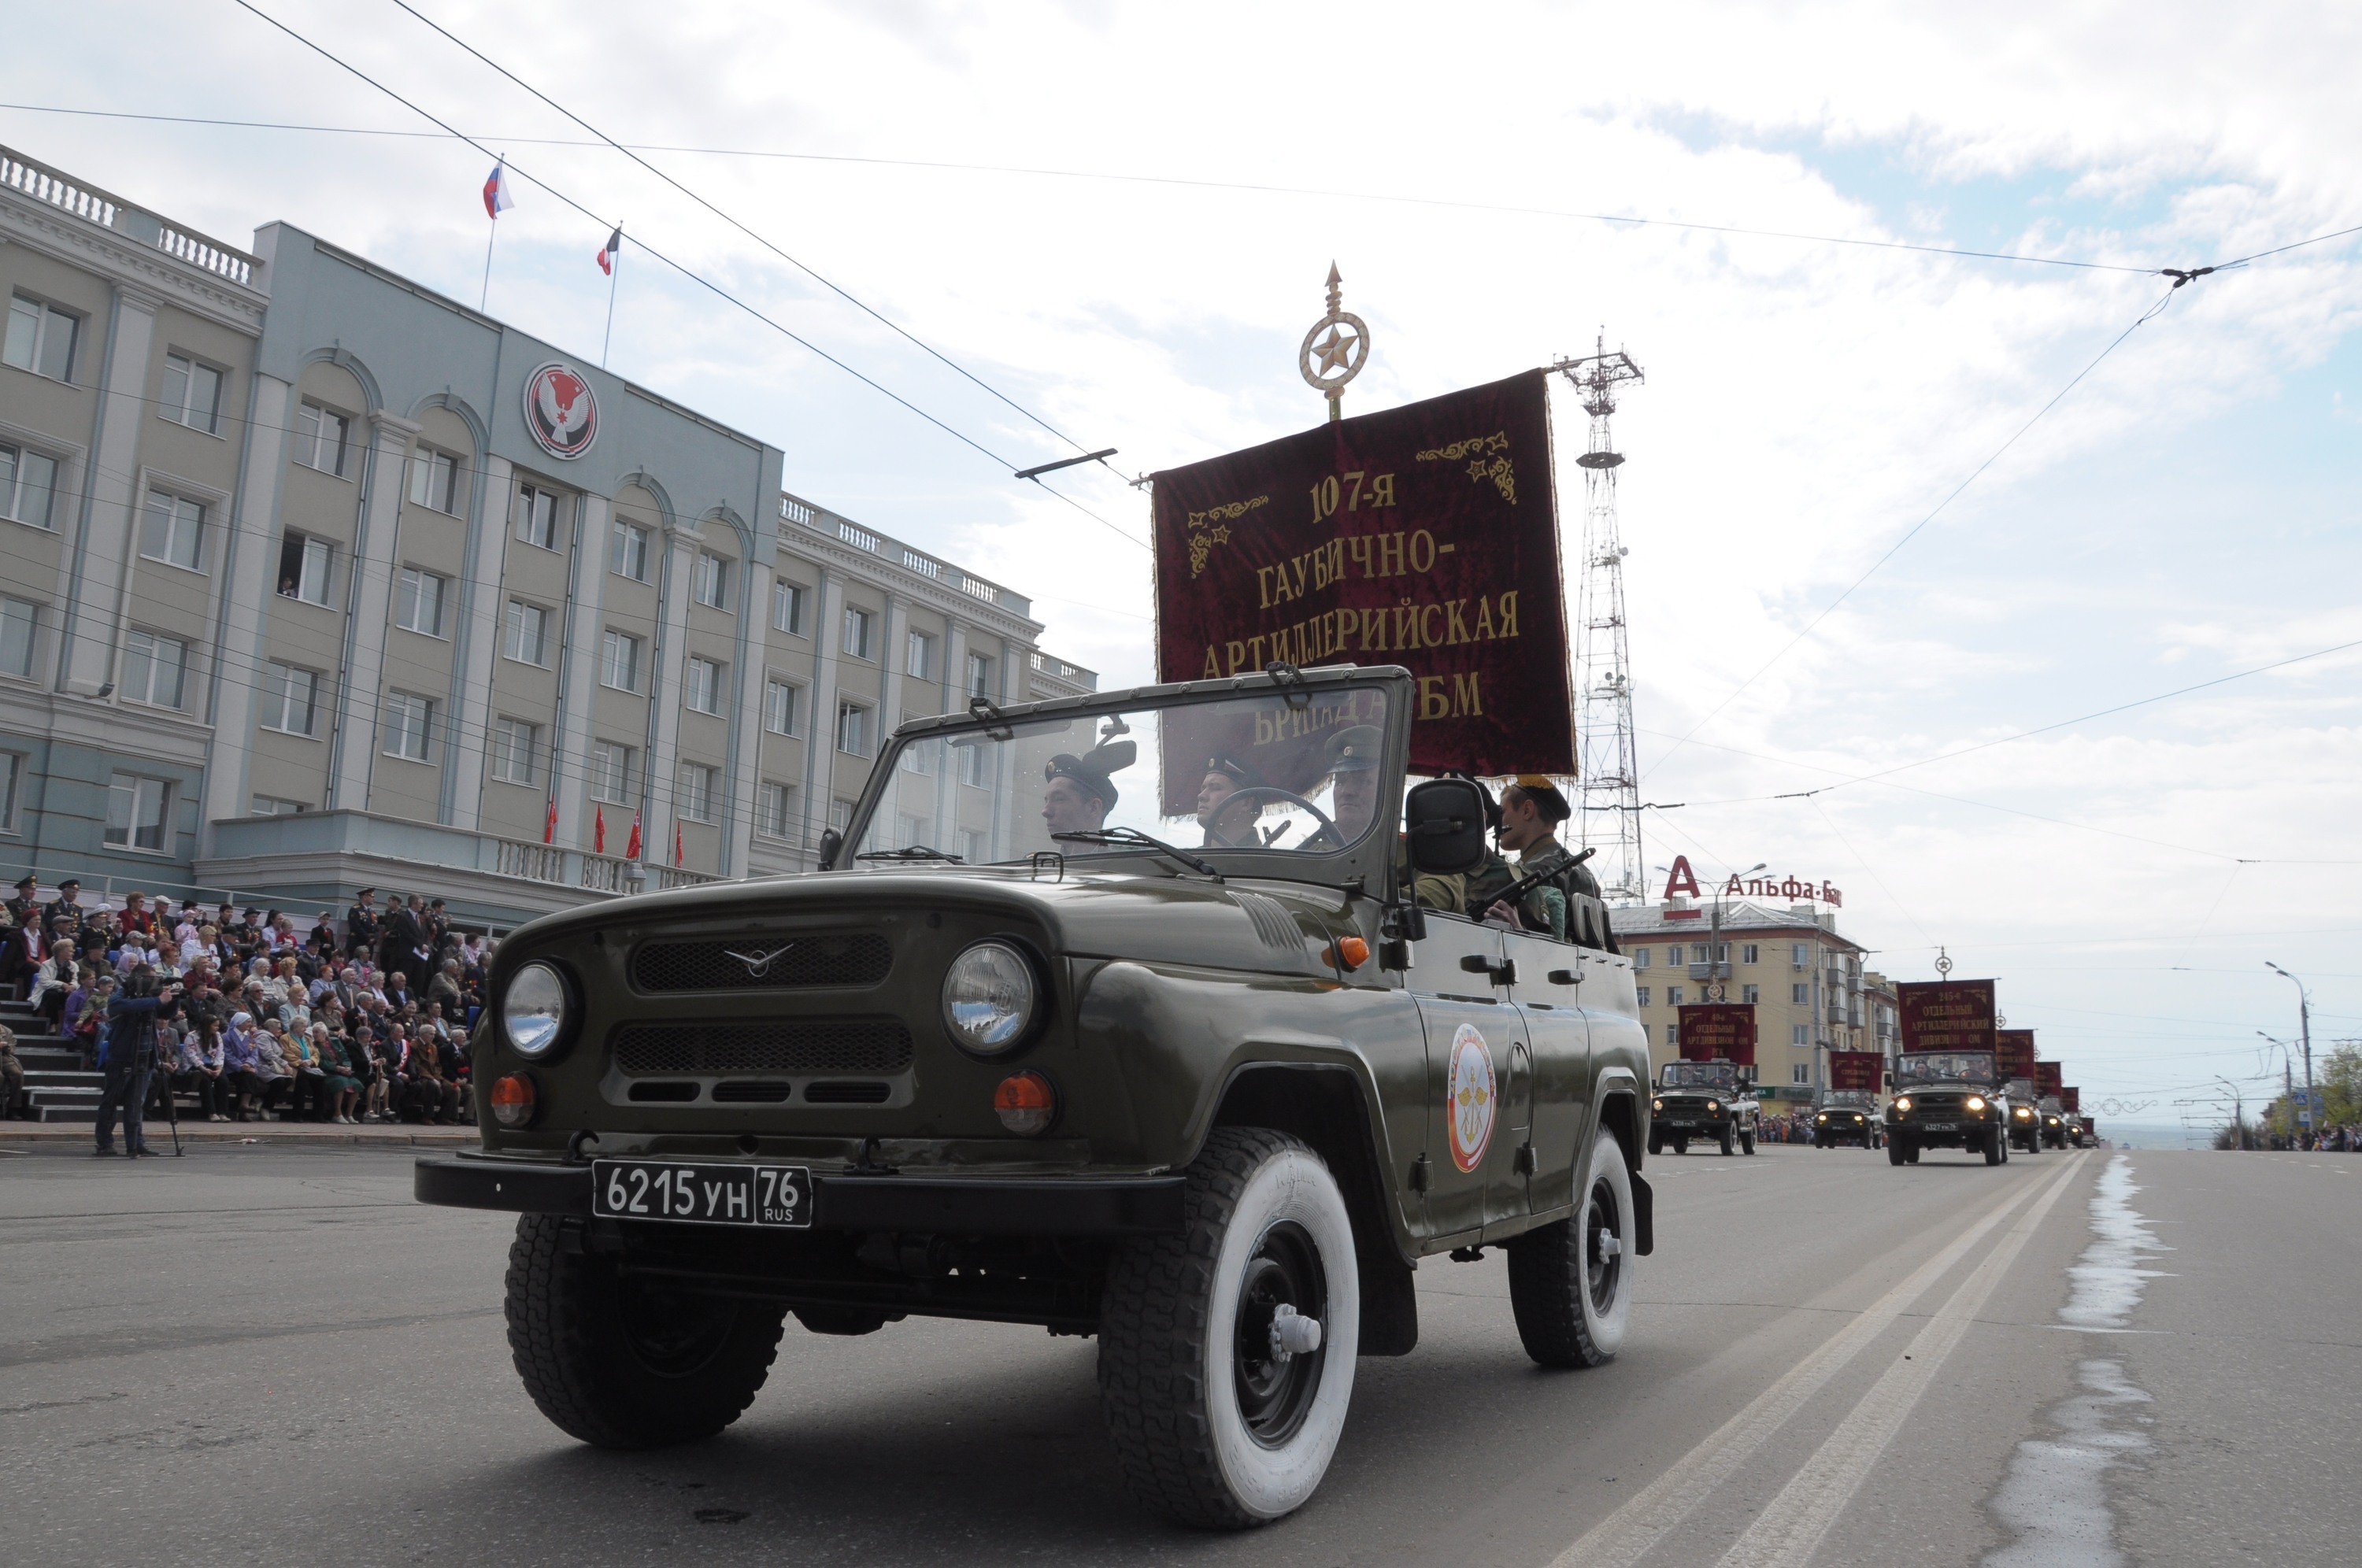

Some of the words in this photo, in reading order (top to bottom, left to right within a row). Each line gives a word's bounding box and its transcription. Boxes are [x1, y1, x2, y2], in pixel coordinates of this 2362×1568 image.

[1257, 529, 1455, 610] ГАУБИЧНО-
[1203, 590, 1520, 680] АРТИЛЛЕРИЙСКАЯ
[1417, 671, 1483, 721] БМ
[1912, 1017, 1990, 1032] АРТИЛЛЕРИЙСКИЙ
[1923, 1004, 1972, 1017] ОТДЕЛЬНЫЙ
[608, 1167, 695, 1215] 6215
[760, 1171, 799, 1208] 76
[764, 1208, 794, 1222] RUS
